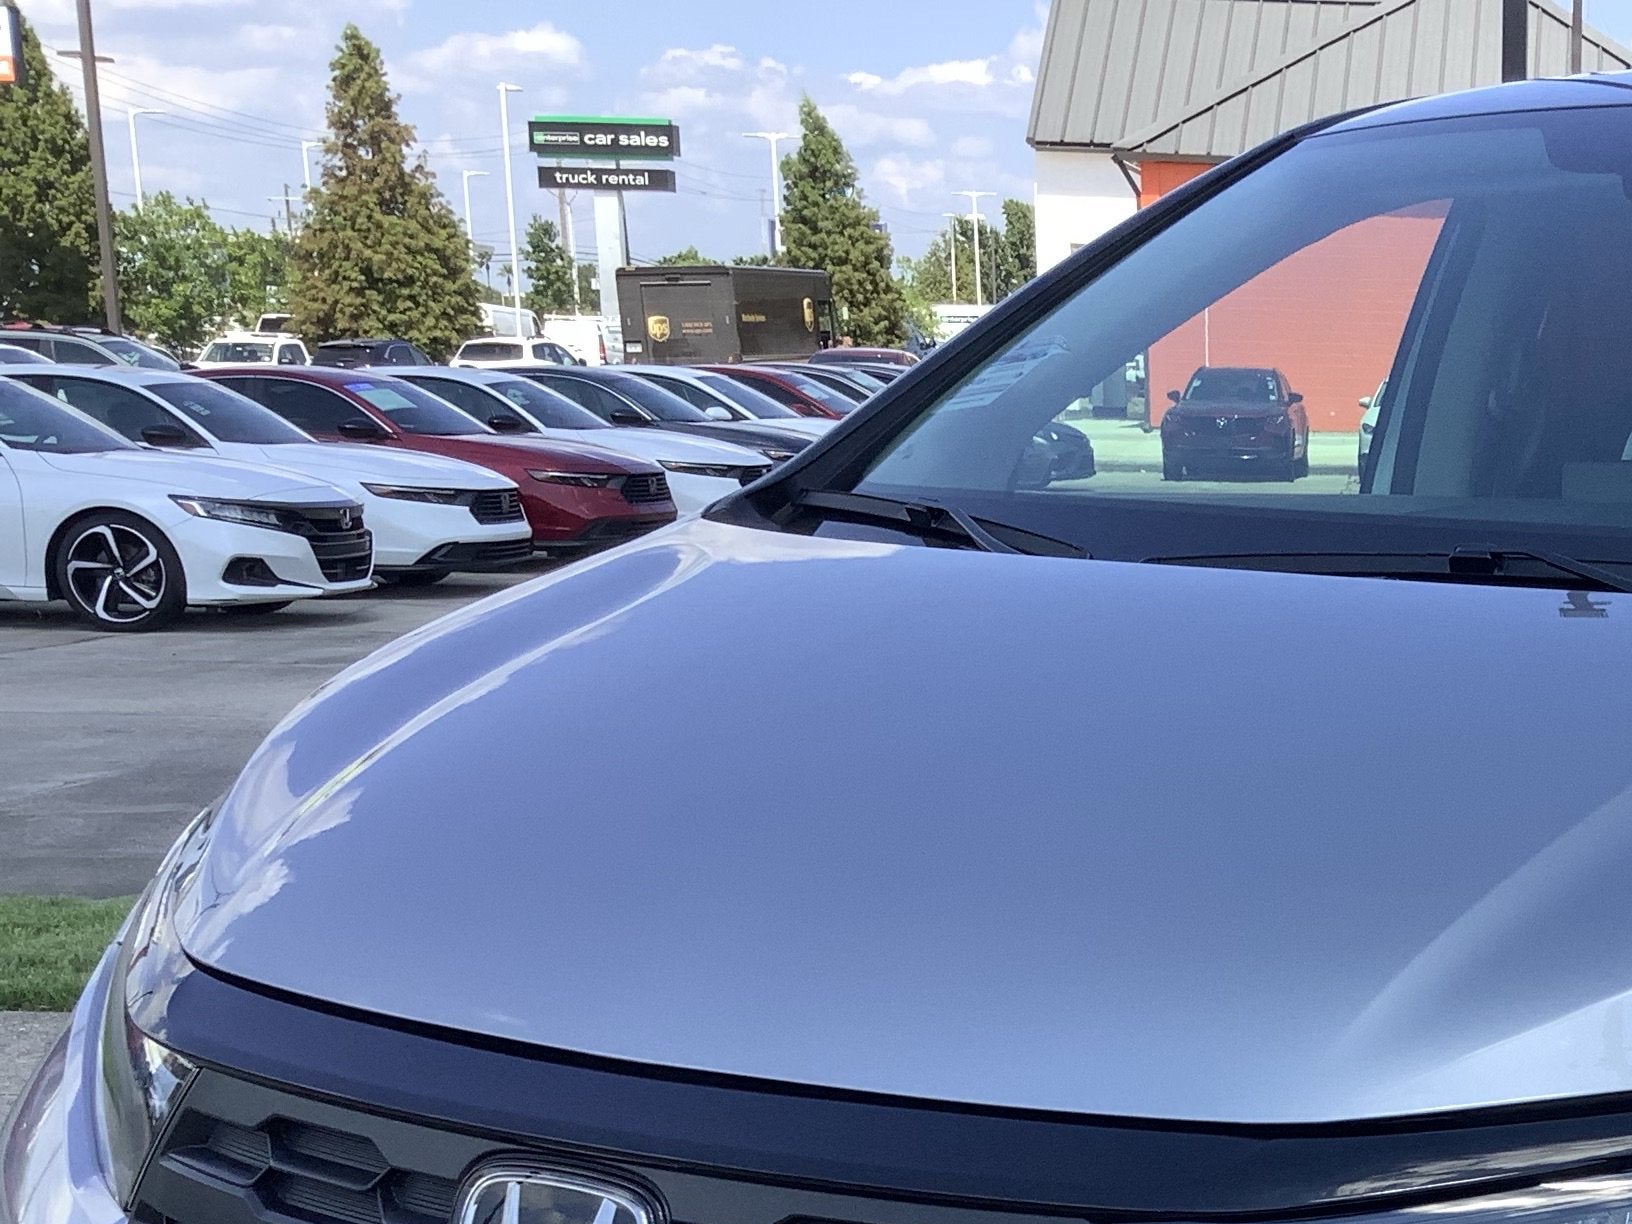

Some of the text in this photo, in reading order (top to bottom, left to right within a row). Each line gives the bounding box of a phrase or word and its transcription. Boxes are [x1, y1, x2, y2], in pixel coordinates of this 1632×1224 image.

[584, 134, 615, 145] car
[618, 131, 670, 147] sales
[554, 170, 649, 185] truck rental
